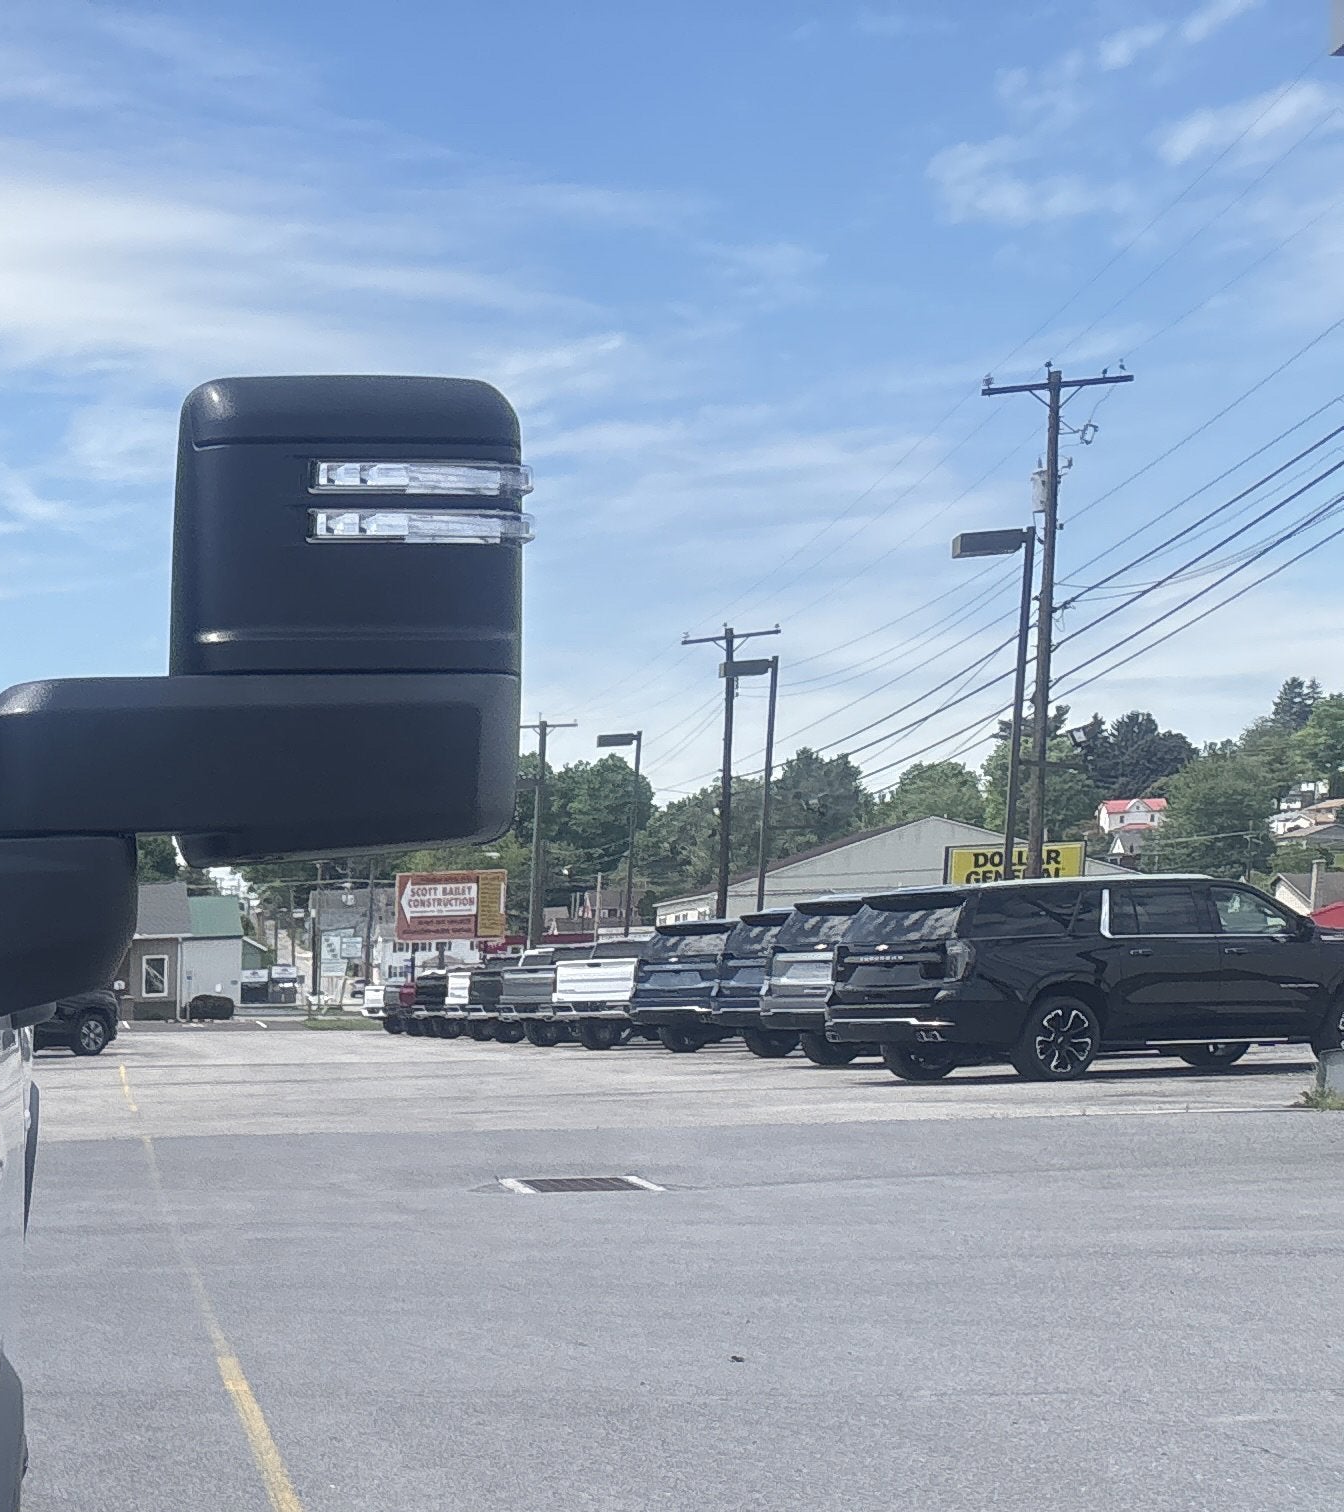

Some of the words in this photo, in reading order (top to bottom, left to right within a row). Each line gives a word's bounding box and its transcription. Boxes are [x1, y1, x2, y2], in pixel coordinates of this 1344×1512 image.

[973, 849, 1061, 868] DOLR
[410, 887, 438, 897] SCOTT
[442, 886, 472, 896] BAILEY
[408, 897, 475, 908] CONSTRUCTION
